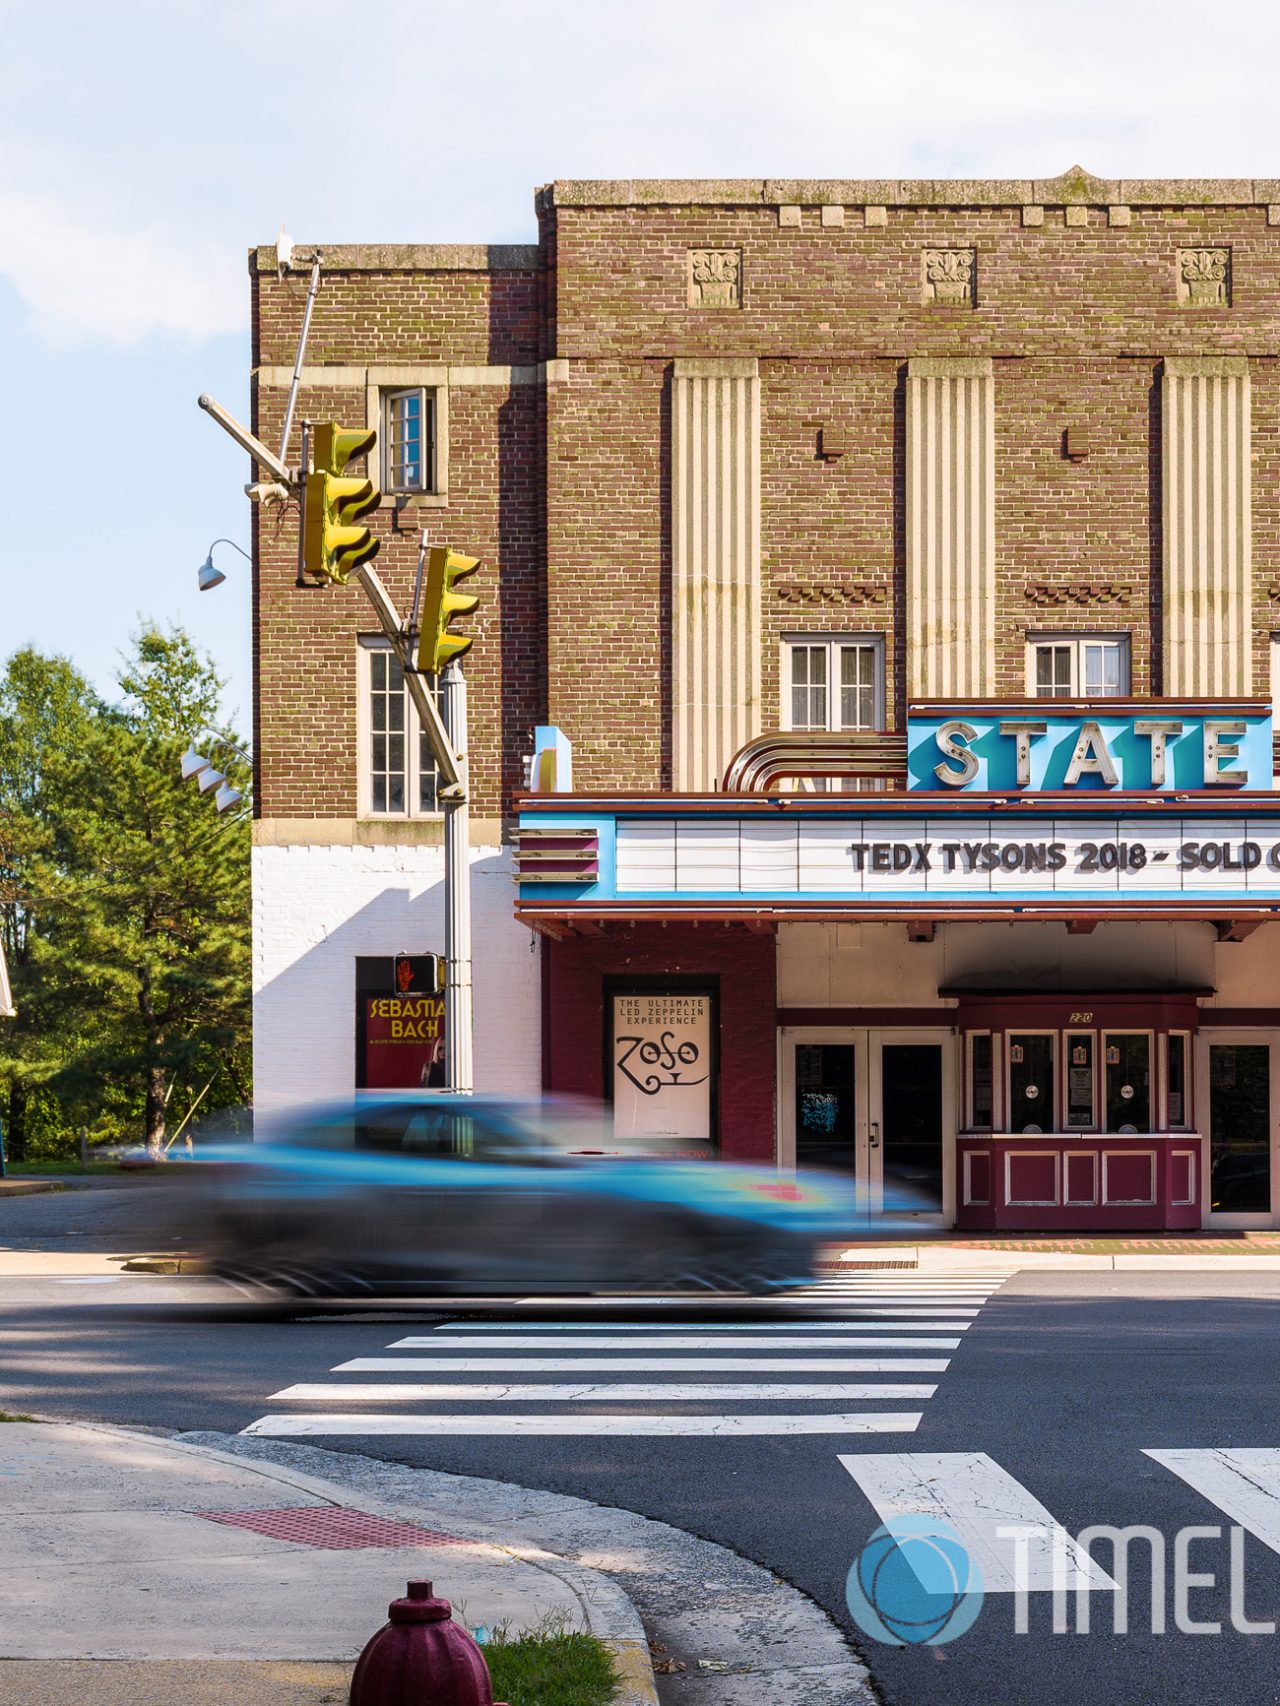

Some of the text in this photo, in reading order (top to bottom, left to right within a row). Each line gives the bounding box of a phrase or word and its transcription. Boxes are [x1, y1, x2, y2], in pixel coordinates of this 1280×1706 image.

[934, 720, 1249, 786] STATE
[851, 842, 932, 870] TEDX
[942, 842, 1067, 870] TYSONS
[1080, 842, 1147, 870] 2018
[1181, 841, 1262, 870] SOLD
[370, 999, 446, 1018] SEBASTIA
[620, 1008, 704, 1016] LED ZEPPELIN
[392, 1020, 438, 1038] BACH
